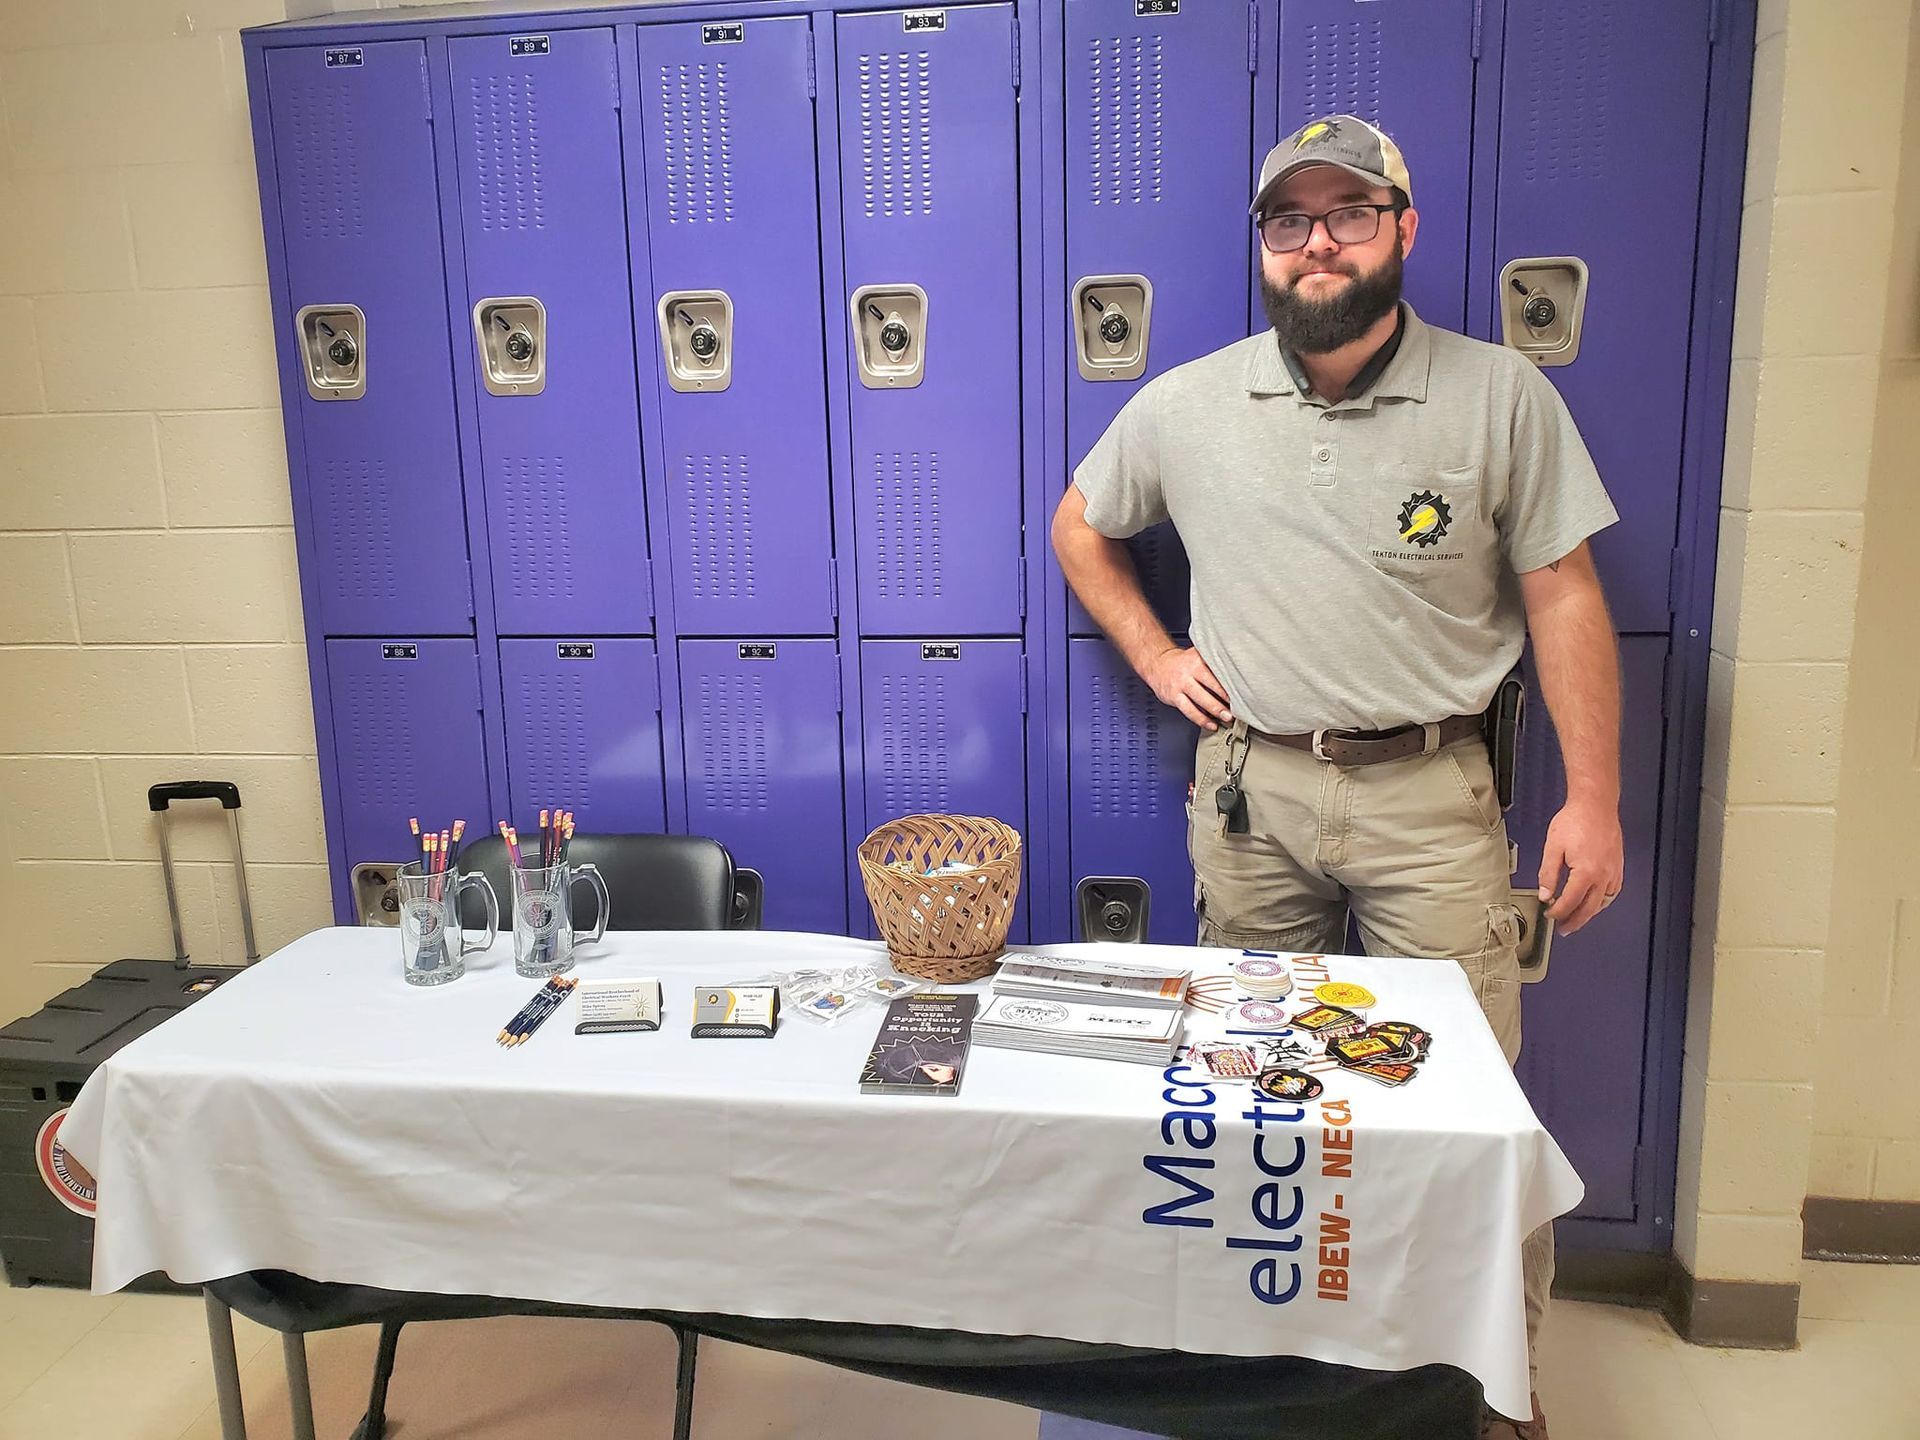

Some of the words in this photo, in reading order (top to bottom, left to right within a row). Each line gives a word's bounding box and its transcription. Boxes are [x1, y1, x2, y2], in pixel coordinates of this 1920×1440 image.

[1151, 1, 1163, 11] 95
[918, 17, 930, 27] 93
[718, 29, 727, 39] 91
[524, 42, 534, 52] 89
[338, 54, 348, 63] 87
[1399, 552, 1435, 561] ELECTRICAL
[1436, 552, 1464, 561] SERVICES
[394, 648, 404, 656] 88
[570, 647, 580, 656] 90
[751, 648, 762, 656] 92
[935, 648, 945, 657] 94
[891, 1016, 963, 1024] Opportunity
[886, 1024, 962, 1034] Knocking
[1142, 1047, 1217, 1229] Maco
[1320, 1098, 1354, 1179] NECA
[53, 1152, 95, 1200] INTERNATIONAL
